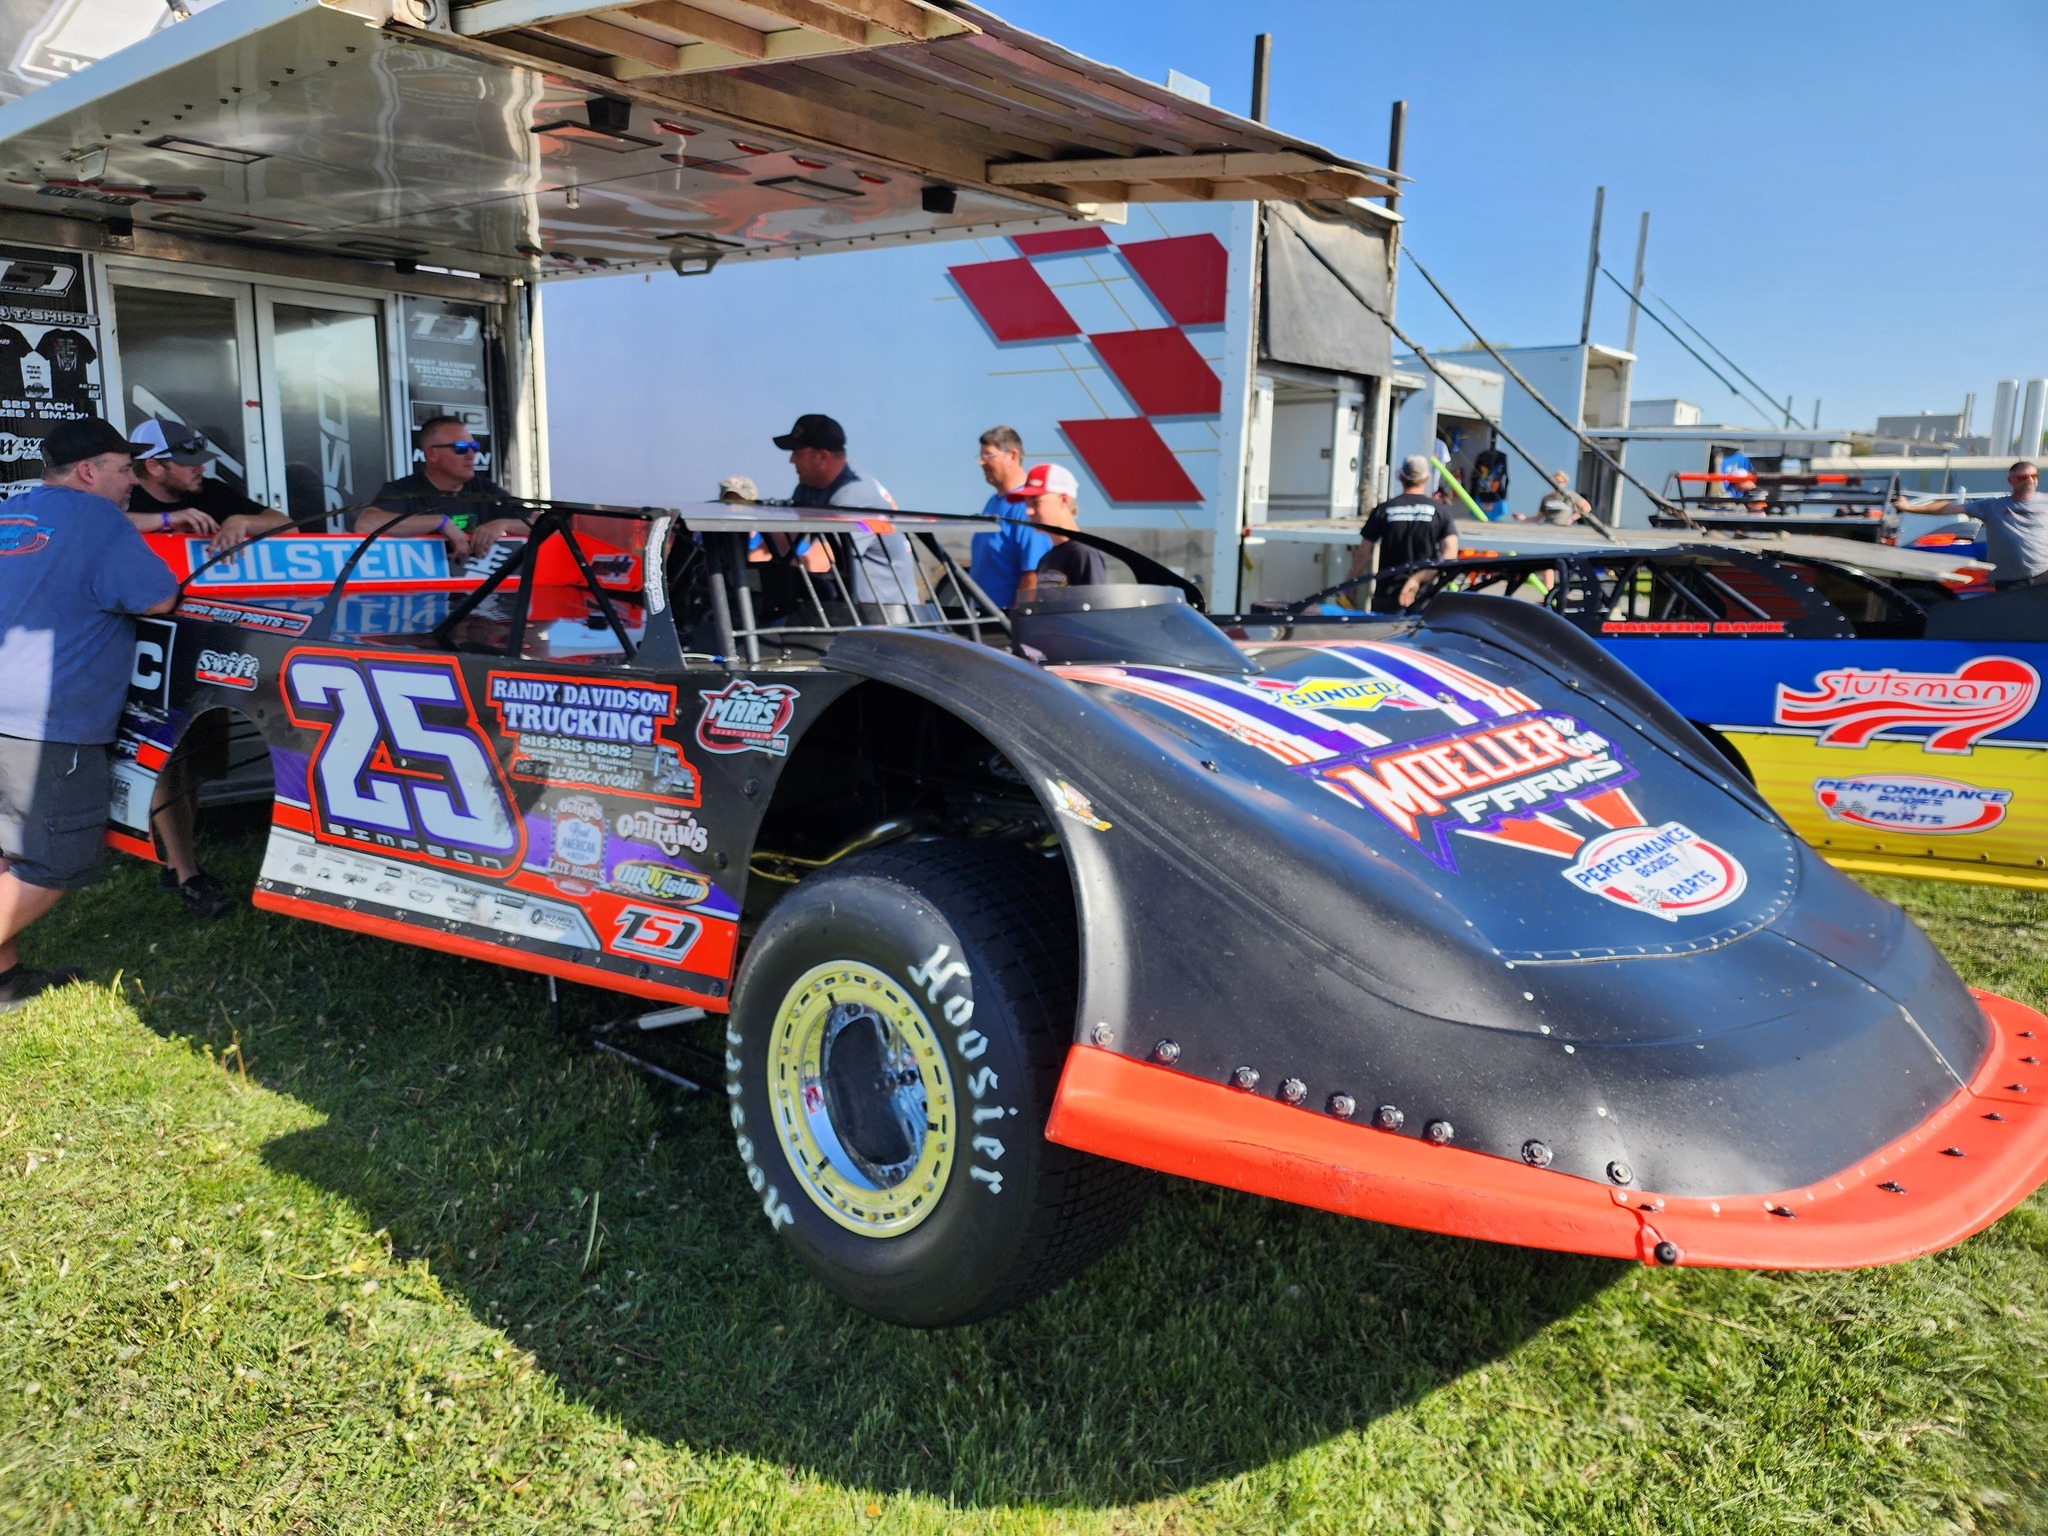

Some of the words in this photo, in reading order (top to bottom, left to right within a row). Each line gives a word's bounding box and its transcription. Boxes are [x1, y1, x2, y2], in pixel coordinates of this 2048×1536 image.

[11, 307, 99, 326] T-SHIRTS
[415, 365, 473, 379] TRUCKING
[35, 401, 74, 412] EACH
[40, 411, 89, 421] SM-3X
[201, 542, 437, 582] BILSTEIN
[180, 603, 212, 615] NAPA
[208, 606, 243, 619] AUTO
[240, 611, 285, 628] PARTS
[1602, 621, 1710, 633] MALVERN
[1713, 621, 1786, 633] BANK
[200, 650, 260, 677] Swift
[493, 678, 560, 702] RANDY
[562, 684, 669, 713] DAVIDSON
[1286, 681, 1393, 706] SUNOCO
[1810, 671, 2008, 701] Stutsman
[502, 701, 655, 744] TRUCKING
[707, 698, 781, 727] MARS
[290, 662, 515, 850] 25
[1327, 718, 1592, 838] MOELLER
[1450, 752, 1624, 824] FARMS
[1817, 780, 2010, 802] PERFORMANCE
[1877, 794, 1944, 807] BODIES
[653, 806, 680, 819] WORLD
[1870, 811, 1946, 825] PARTS
[563, 837, 597, 854] AMERICAN
[1573, 826, 1691, 888] PERFORMANCE
[1634, 852, 1680, 878] BODIES
[1666, 869, 1718, 901] PARTS
